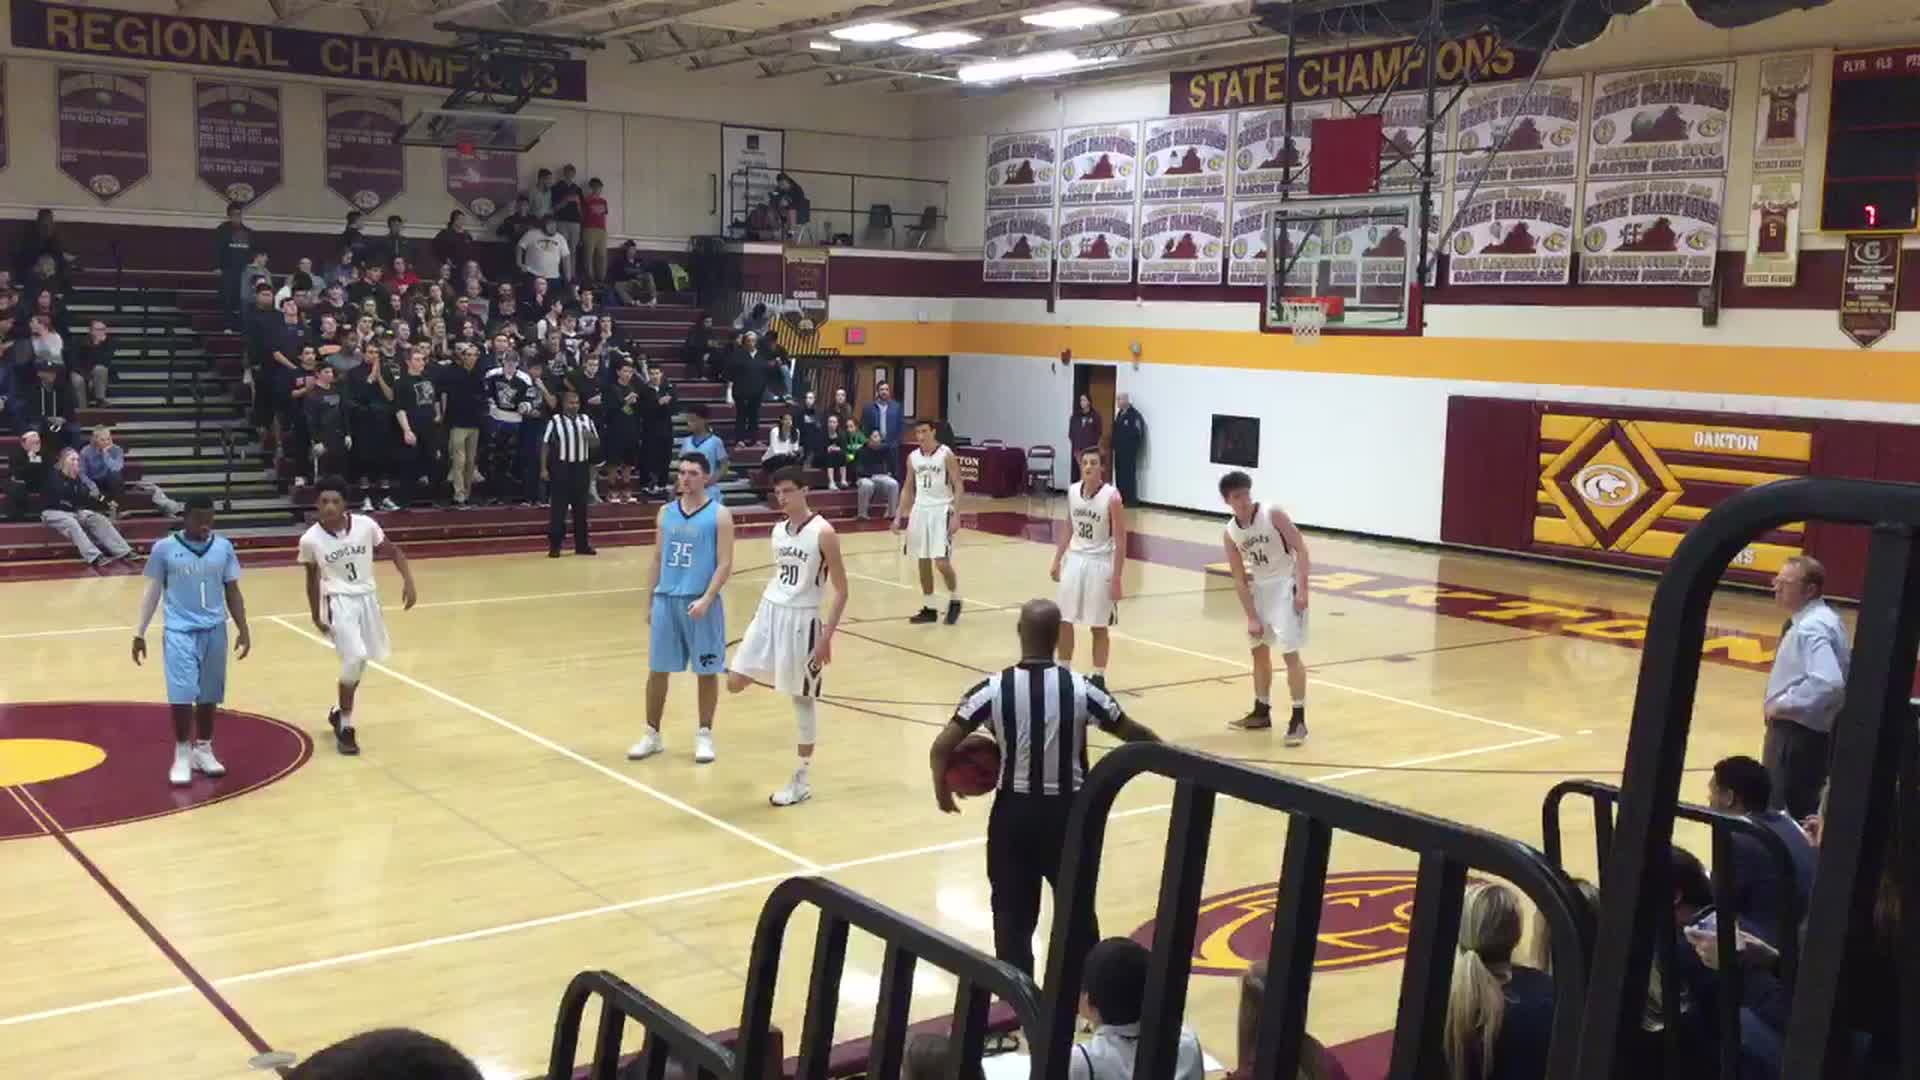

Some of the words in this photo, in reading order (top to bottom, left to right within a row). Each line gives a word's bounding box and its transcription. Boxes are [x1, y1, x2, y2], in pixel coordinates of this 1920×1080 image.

[47, 7, 289, 67] REGIONAL
[320, 37, 561, 96] CHAMPS
[1188, 62, 1286, 109] STATE
[1298, 33, 1515, 98] CHAMPONS
[1494, 197, 1573, 229] CHAMPIONS
[1585, 196, 1630, 229] STATE
[1631, 191, 1720, 226] CHAMPIONS
[1864, 205, 1876, 225] 7
[1694, 431, 1760, 452] OAKTON
[959, 456, 980, 466] TON
[1078, 521, 1094, 540] 32
[325, 545, 367, 565] COUGARS
[667, 541, 694, 568] 35
[345, 562, 358, 583] 3
[780, 564, 800, 587] 20
[199, 581, 207, 610] 1
